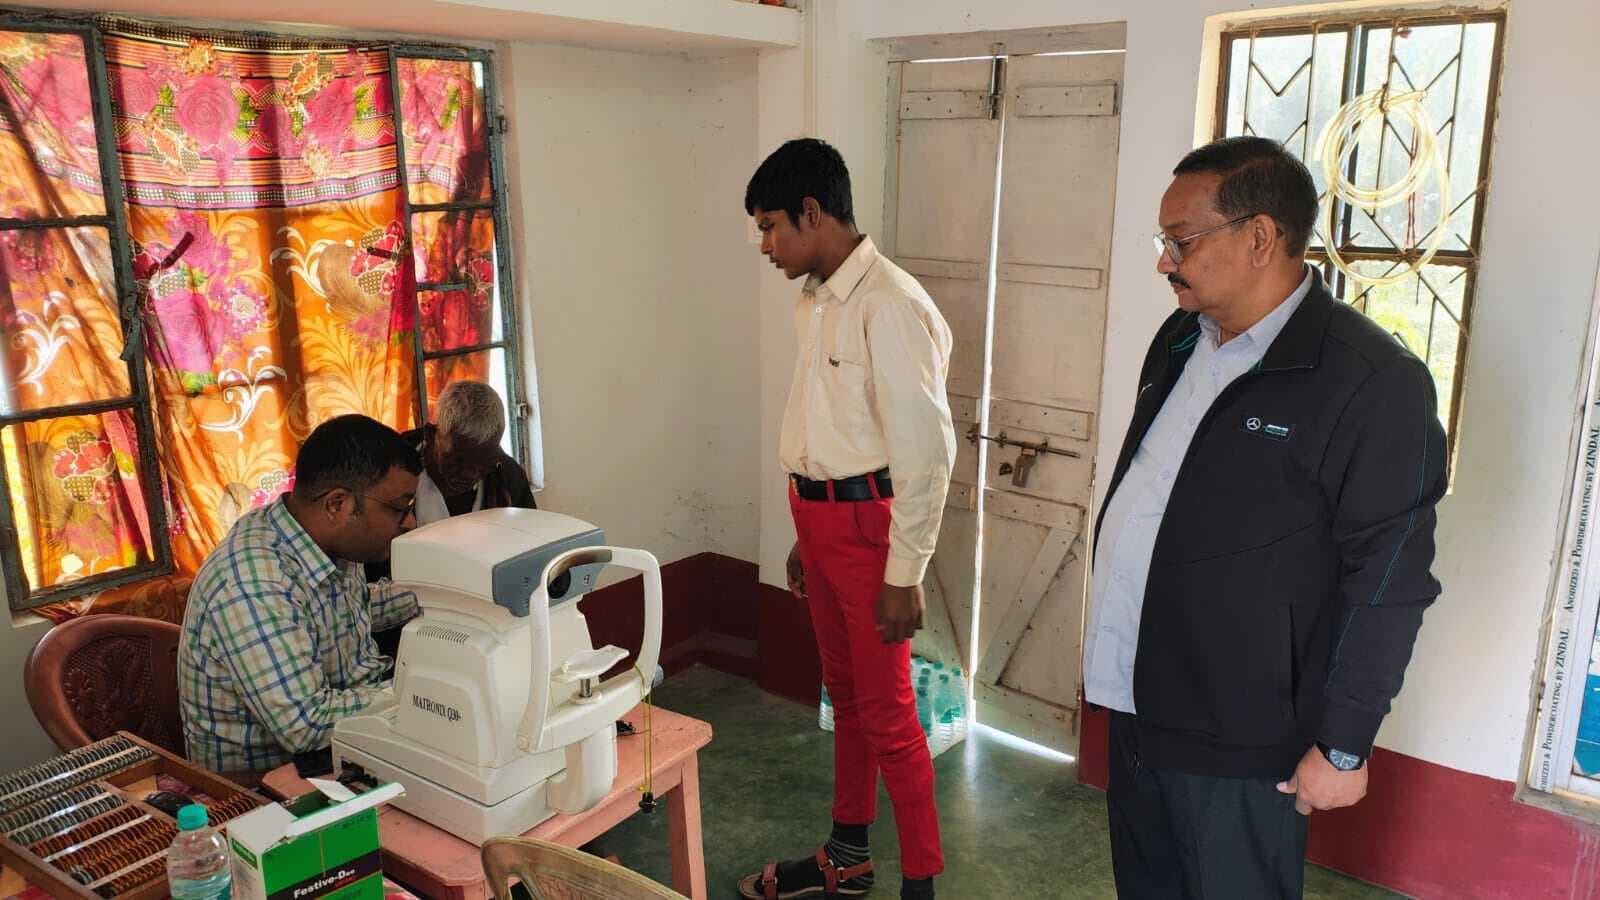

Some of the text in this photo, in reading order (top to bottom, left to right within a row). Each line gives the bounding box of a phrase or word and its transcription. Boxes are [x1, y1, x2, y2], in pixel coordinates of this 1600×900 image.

[1585, 428, 1600, 468] ZINDAL
[1555, 628, 1570, 669] ZINDAL
[412, 694, 446, 717] MATRONIX
